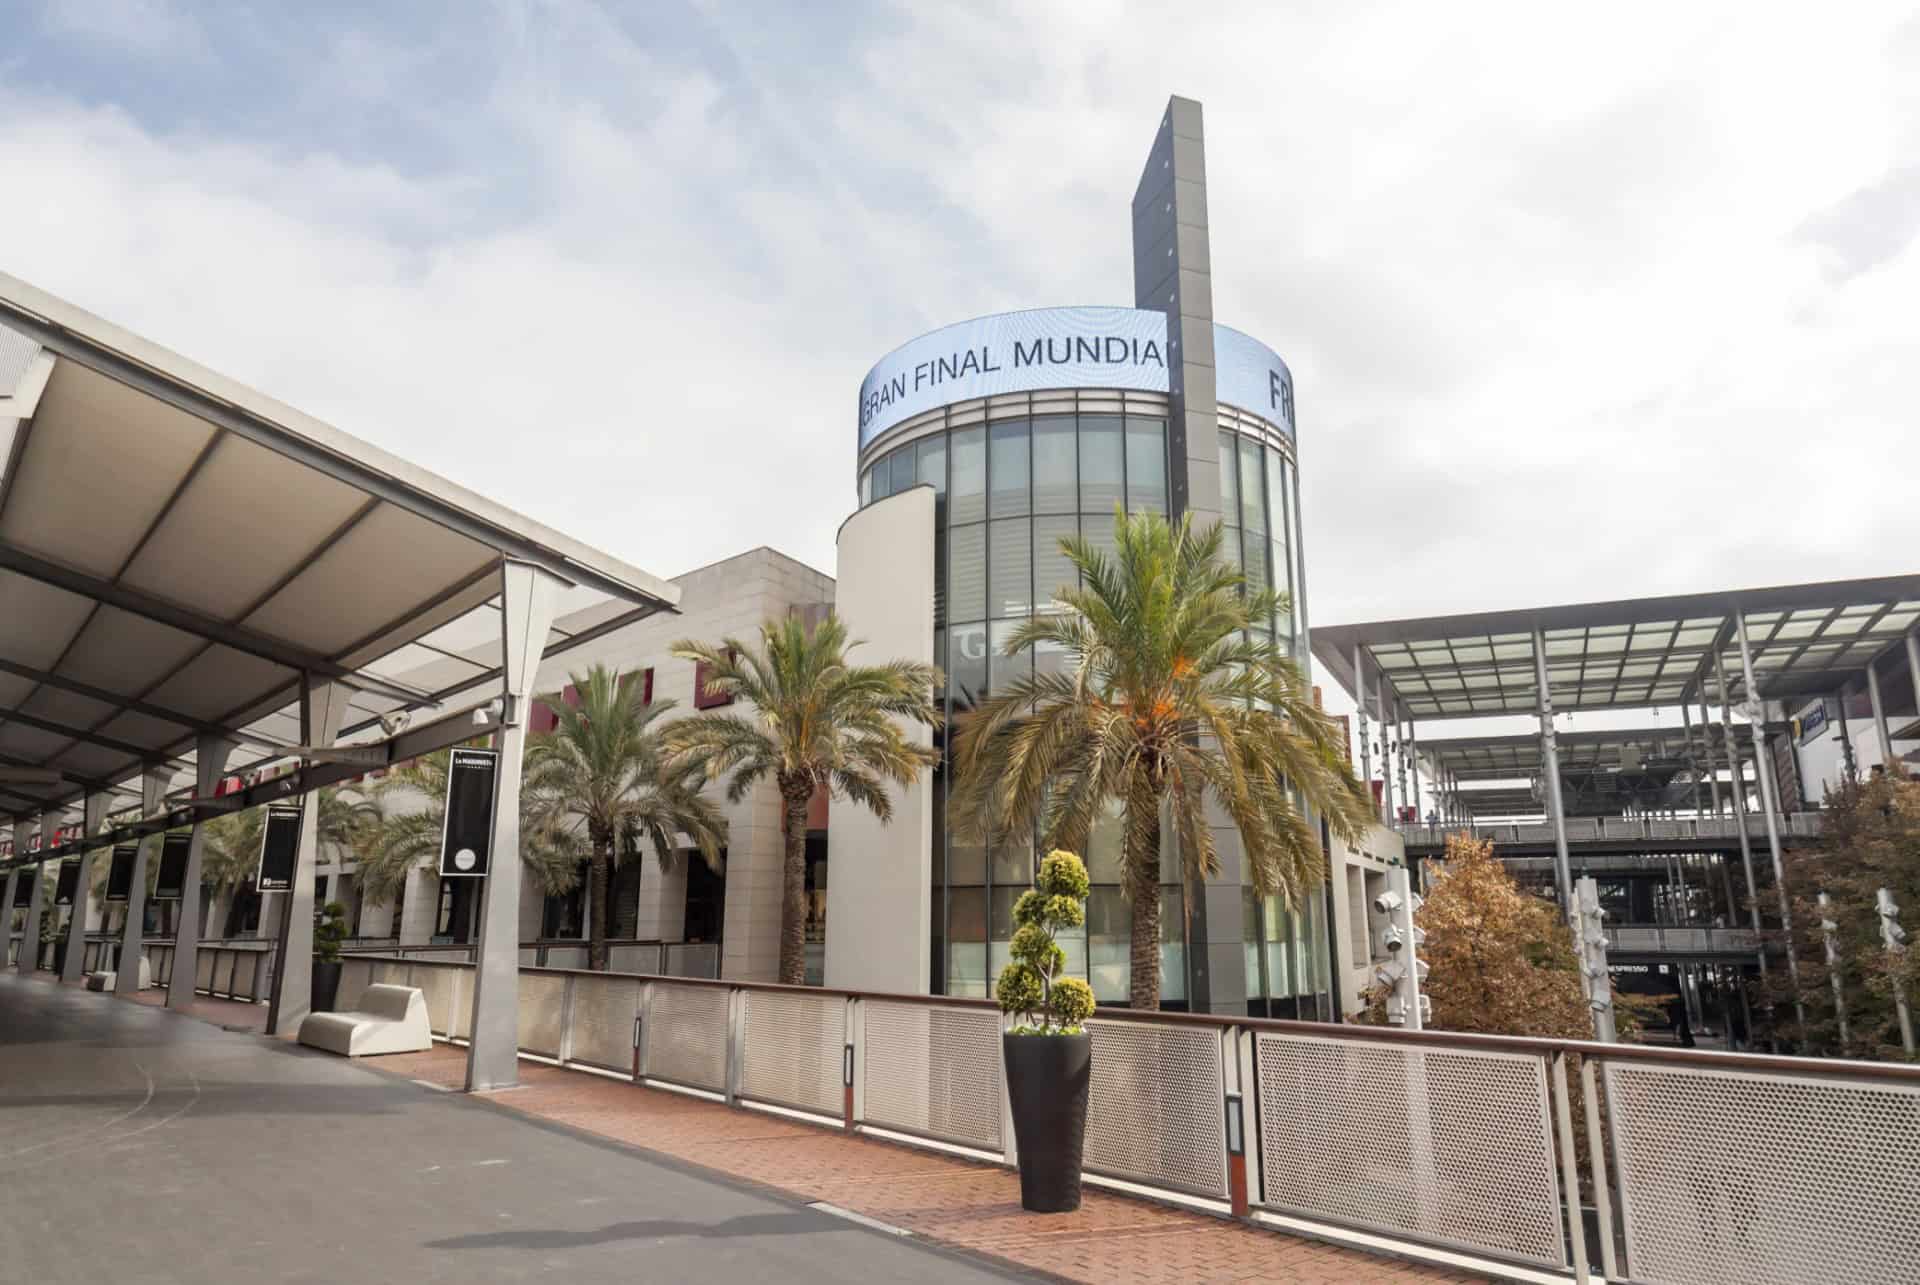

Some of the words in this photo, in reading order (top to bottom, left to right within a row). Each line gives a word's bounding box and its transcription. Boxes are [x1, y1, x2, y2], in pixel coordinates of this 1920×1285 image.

[862, 372, 906, 427] GRAN
[914, 346, 1001, 392] FINAL
[1013, 336, 1169, 368] MUNDIA
